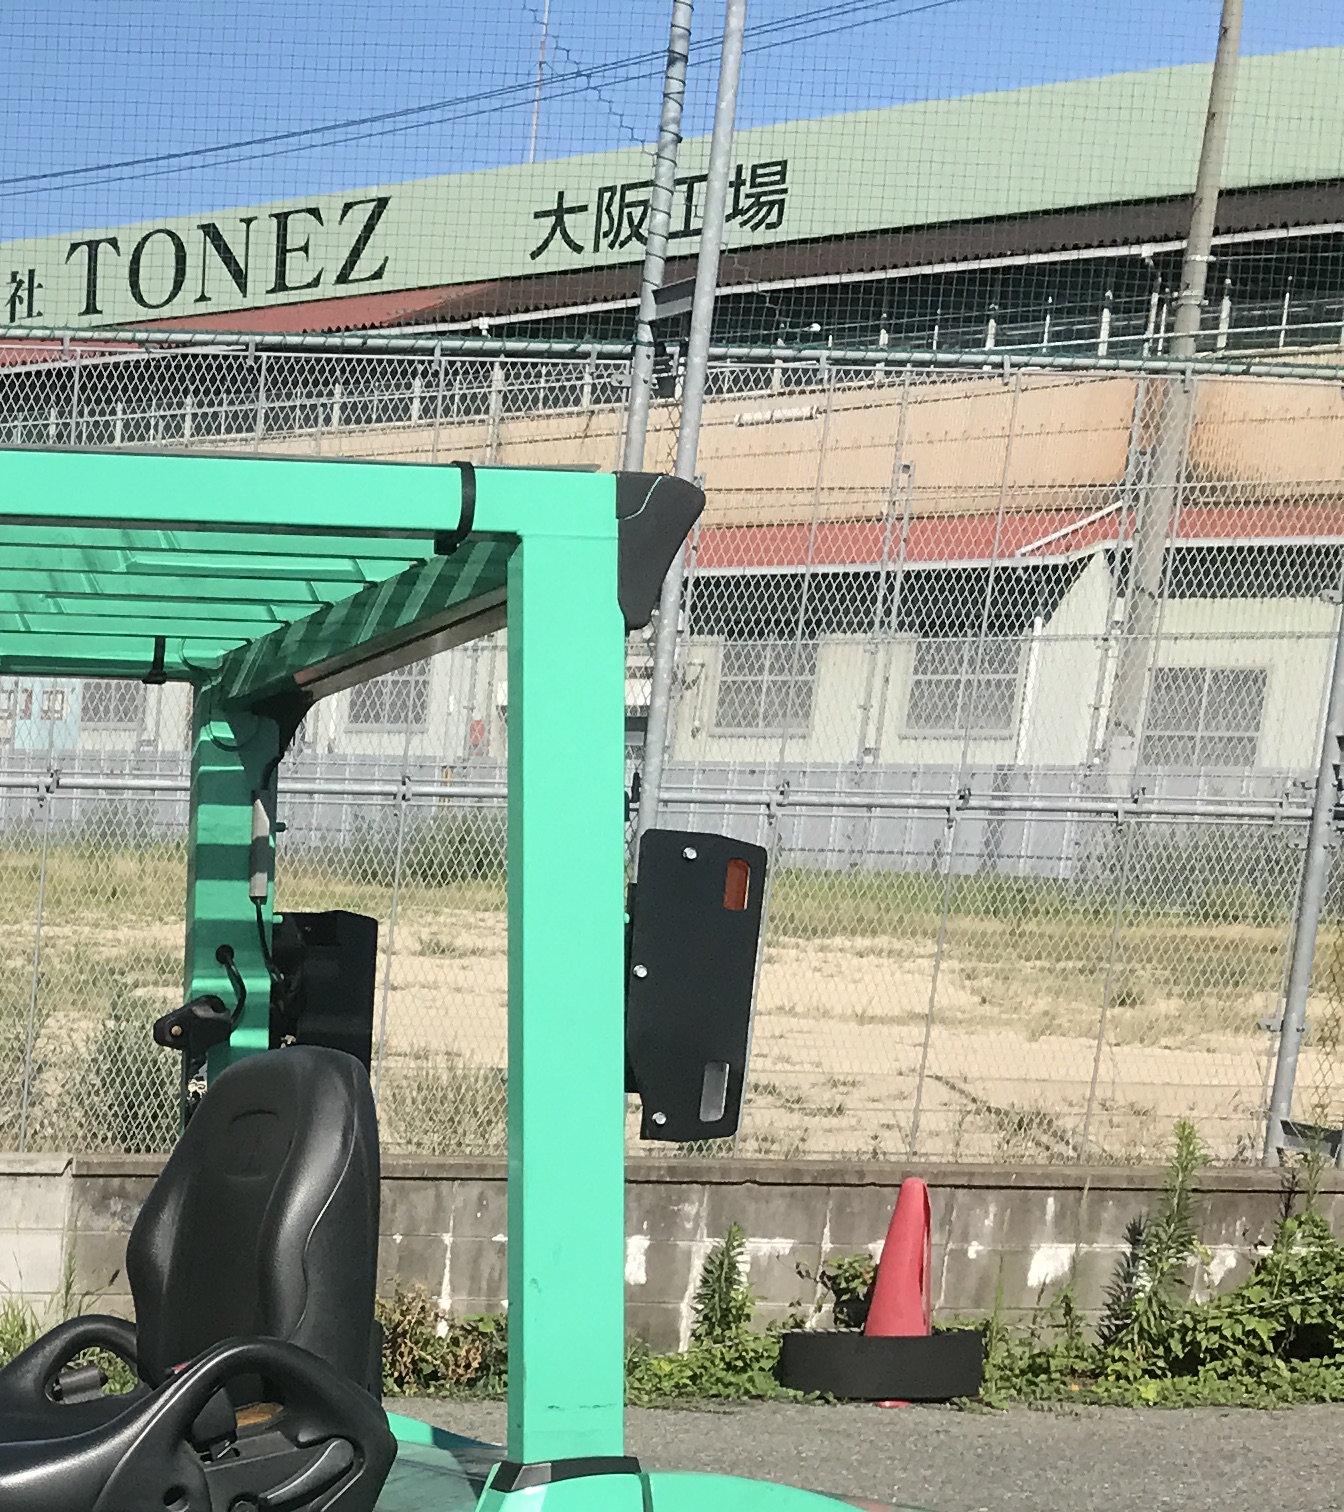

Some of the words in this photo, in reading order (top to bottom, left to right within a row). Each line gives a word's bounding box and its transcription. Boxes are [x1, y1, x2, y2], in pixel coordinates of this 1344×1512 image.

[65, 196, 392, 316] TONEZ
[529, 159, 789, 261] 大阪工場
